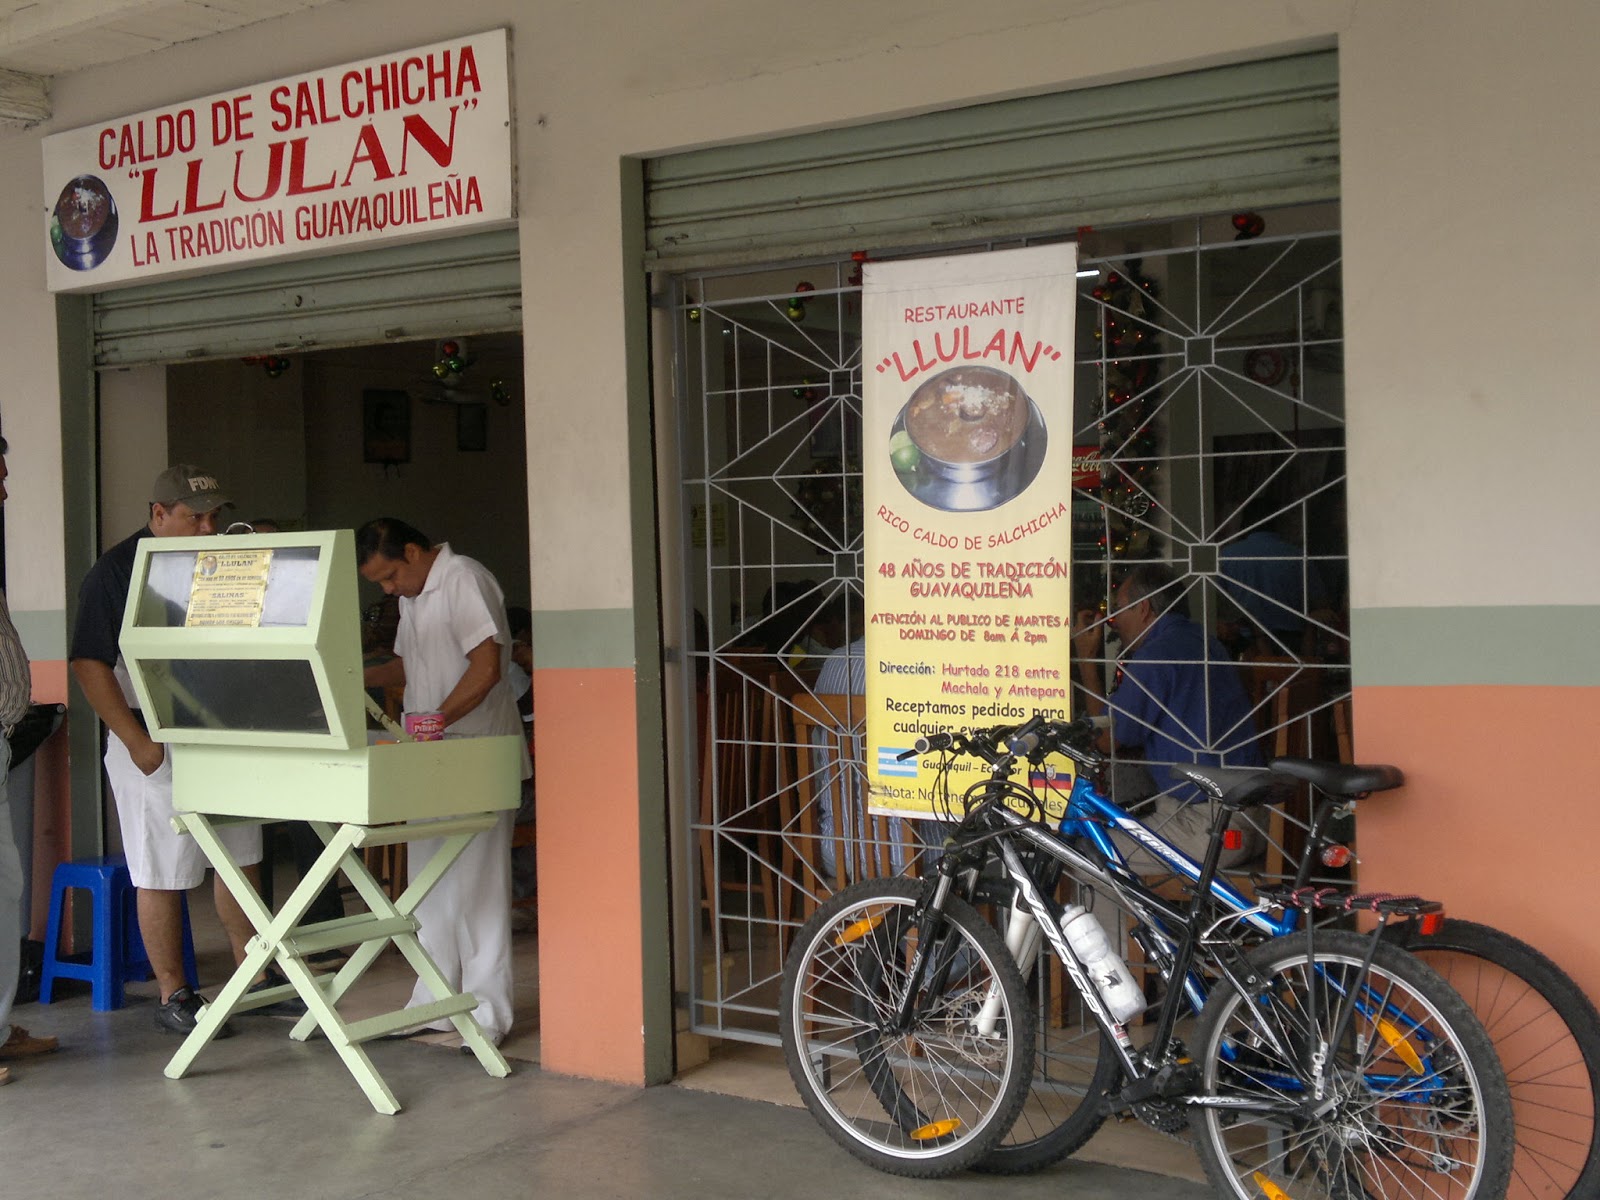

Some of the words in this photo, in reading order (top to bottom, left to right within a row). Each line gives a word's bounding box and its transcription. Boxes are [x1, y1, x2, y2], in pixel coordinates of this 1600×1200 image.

[98, 107, 196, 170] CALDO
[212, 94, 255, 146] DE
[269, 45, 482, 133] SALCHICHA
[130, 234, 160, 267] LA
[165, 207, 285, 261] TRADICIÓN
[295, 173, 484, 241] GUAYAQUILEÑA
[904, 297, 1025, 323] RESTAURANTE
[877, 504, 910, 533] RICO
[913, 527, 959, 549] CALDO
[964, 536, 982, 550] DE
[988, 502, 1067, 548] SALCHICHA
[878, 562, 896, 578] 48
[901, 558, 945, 578] AÑOS
[951, 562, 971, 578] DE
[977, 557, 1068, 579] TRADICIÓN
[910, 577, 1034, 601] GUAYAQUILEÑA
[870, 610, 926, 625] ATENCIÓN
[929, 613, 943, 625] AL
[947, 613, 992, 627] PUBLICO
[995, 614, 1011, 627] DE
[1014, 615, 1061, 628] MARTES
[899, 628, 956, 641] DOMINGO
[960, 629, 976, 642] DE
[983, 630, 1006, 642] 8am
[1024, 630, 1048, 645] 2pm
[879, 660, 936, 675] Dirección:
[942, 663, 990, 677] Hurtado
[994, 664, 1020, 678] 218
[1025, 666, 1060, 680] entre
[941, 681, 989, 695] Machala
[994, 685, 1003, 699] y
[1008, 683, 1066, 700] Antepara
[886, 697, 966, 718] Receptamos
[972, 702, 1025, 719] pedidos
[1032, 706, 1065, 720] para
[893, 719, 954, 736] cualquier
[980, 763, 1022, 775] Ecor
[884, 785, 915, 800] Nota:
[918, 787, 934, 801] No
[1186, 771, 1223, 798] NORCO
